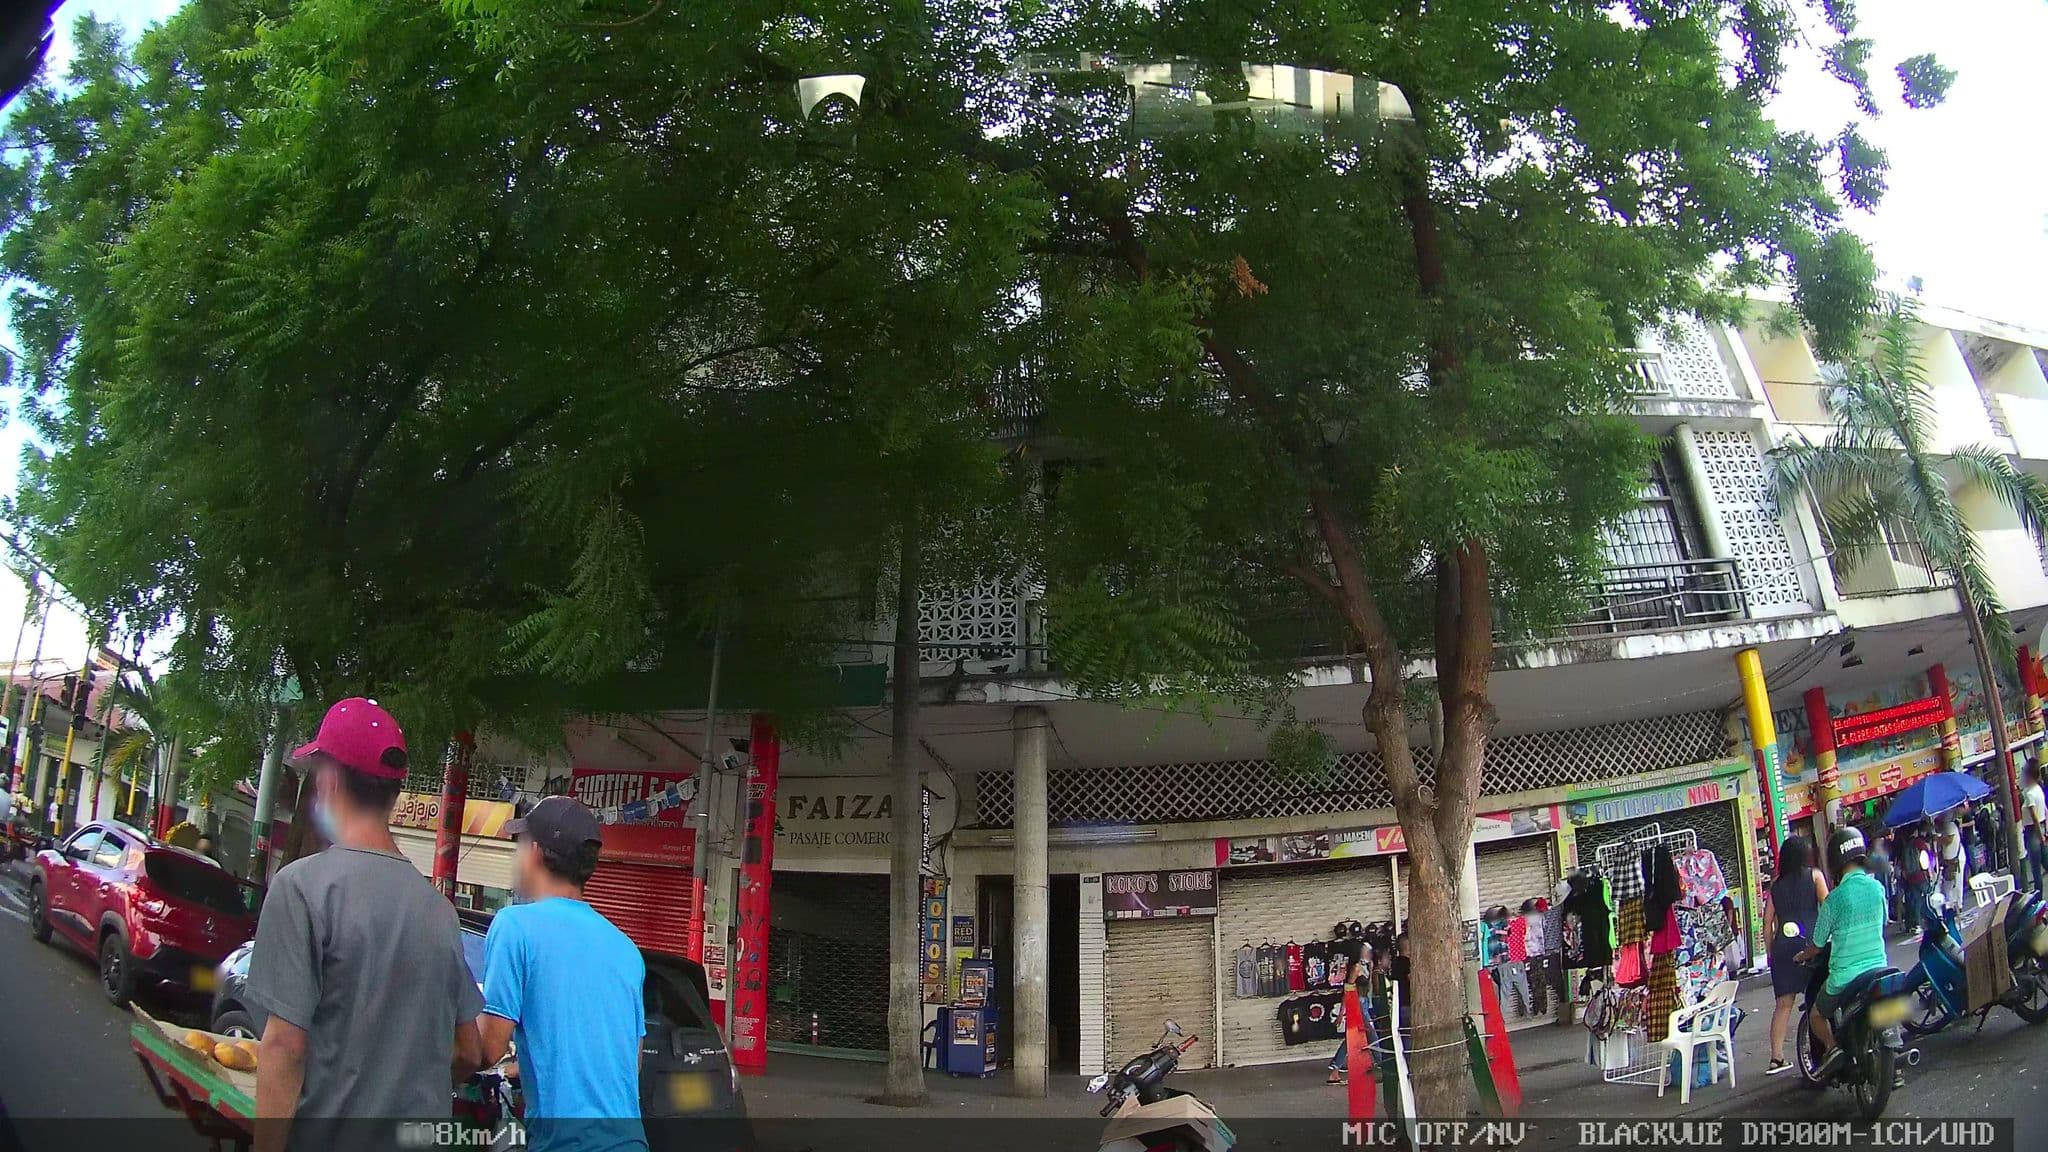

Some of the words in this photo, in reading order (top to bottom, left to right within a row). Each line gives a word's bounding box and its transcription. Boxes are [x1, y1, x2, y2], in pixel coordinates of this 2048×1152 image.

[1686, 779, 1720, 805] NIÑO
[789, 831, 832, 848] PASAJE
[1106, 873, 1159, 894] KOKO'S
[1168, 871, 1213, 892] STORE
[928, 879, 944, 980] FOTOS
[954, 927, 973, 936] RED
